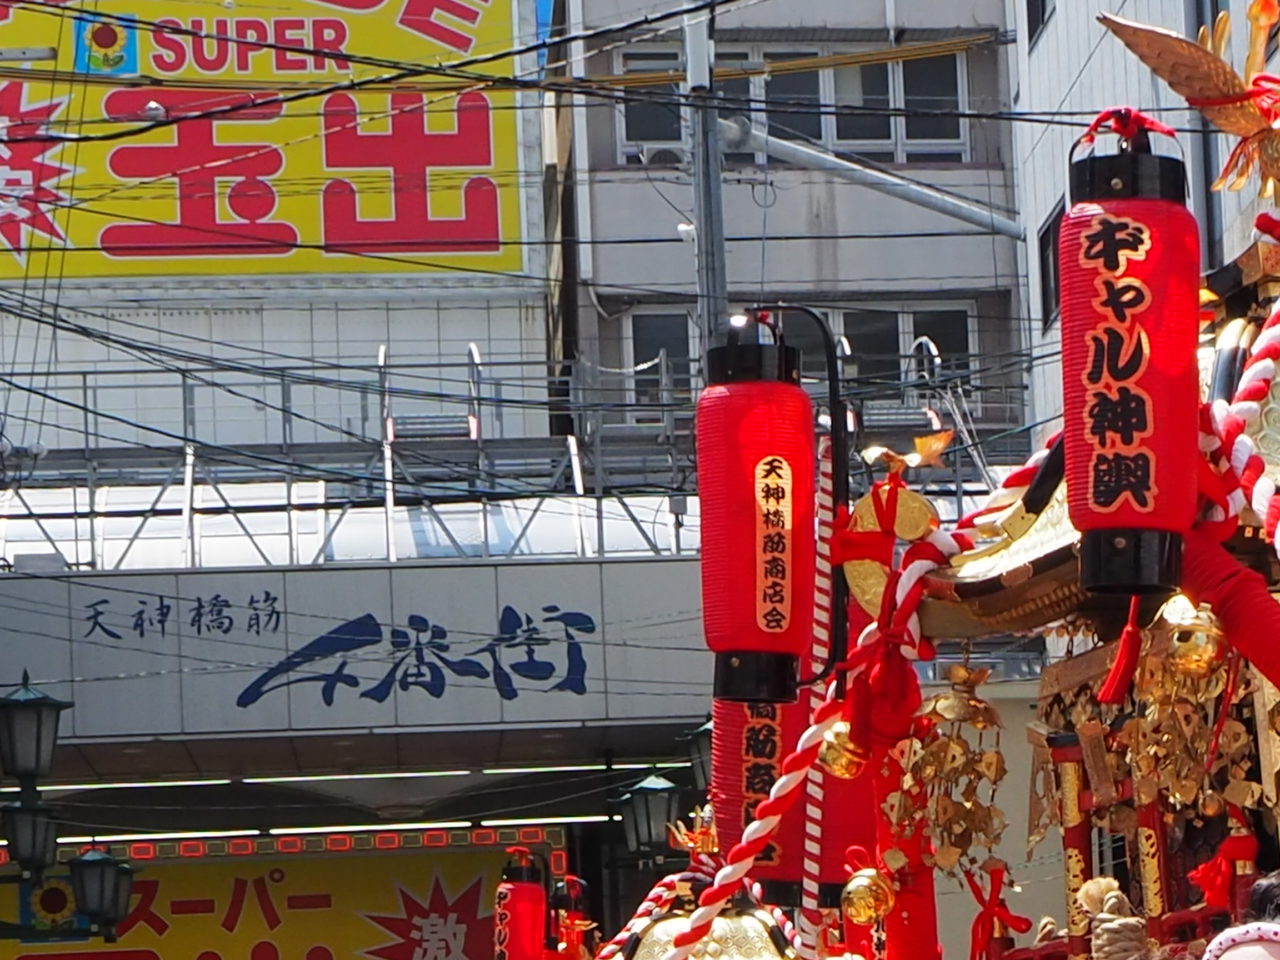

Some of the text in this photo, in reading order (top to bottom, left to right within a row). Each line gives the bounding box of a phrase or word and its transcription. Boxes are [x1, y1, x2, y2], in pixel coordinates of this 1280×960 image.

[150, 17, 352, 73] SUPER
[99, 87, 501, 258] 玉出
[1081, 213, 1156, 513] ギャル神輿
[761, 457, 788, 631] 天神橋筋商店会
[82, 590, 283, 640] 天神橋筋
[116, 868, 332, 938] スーパー
